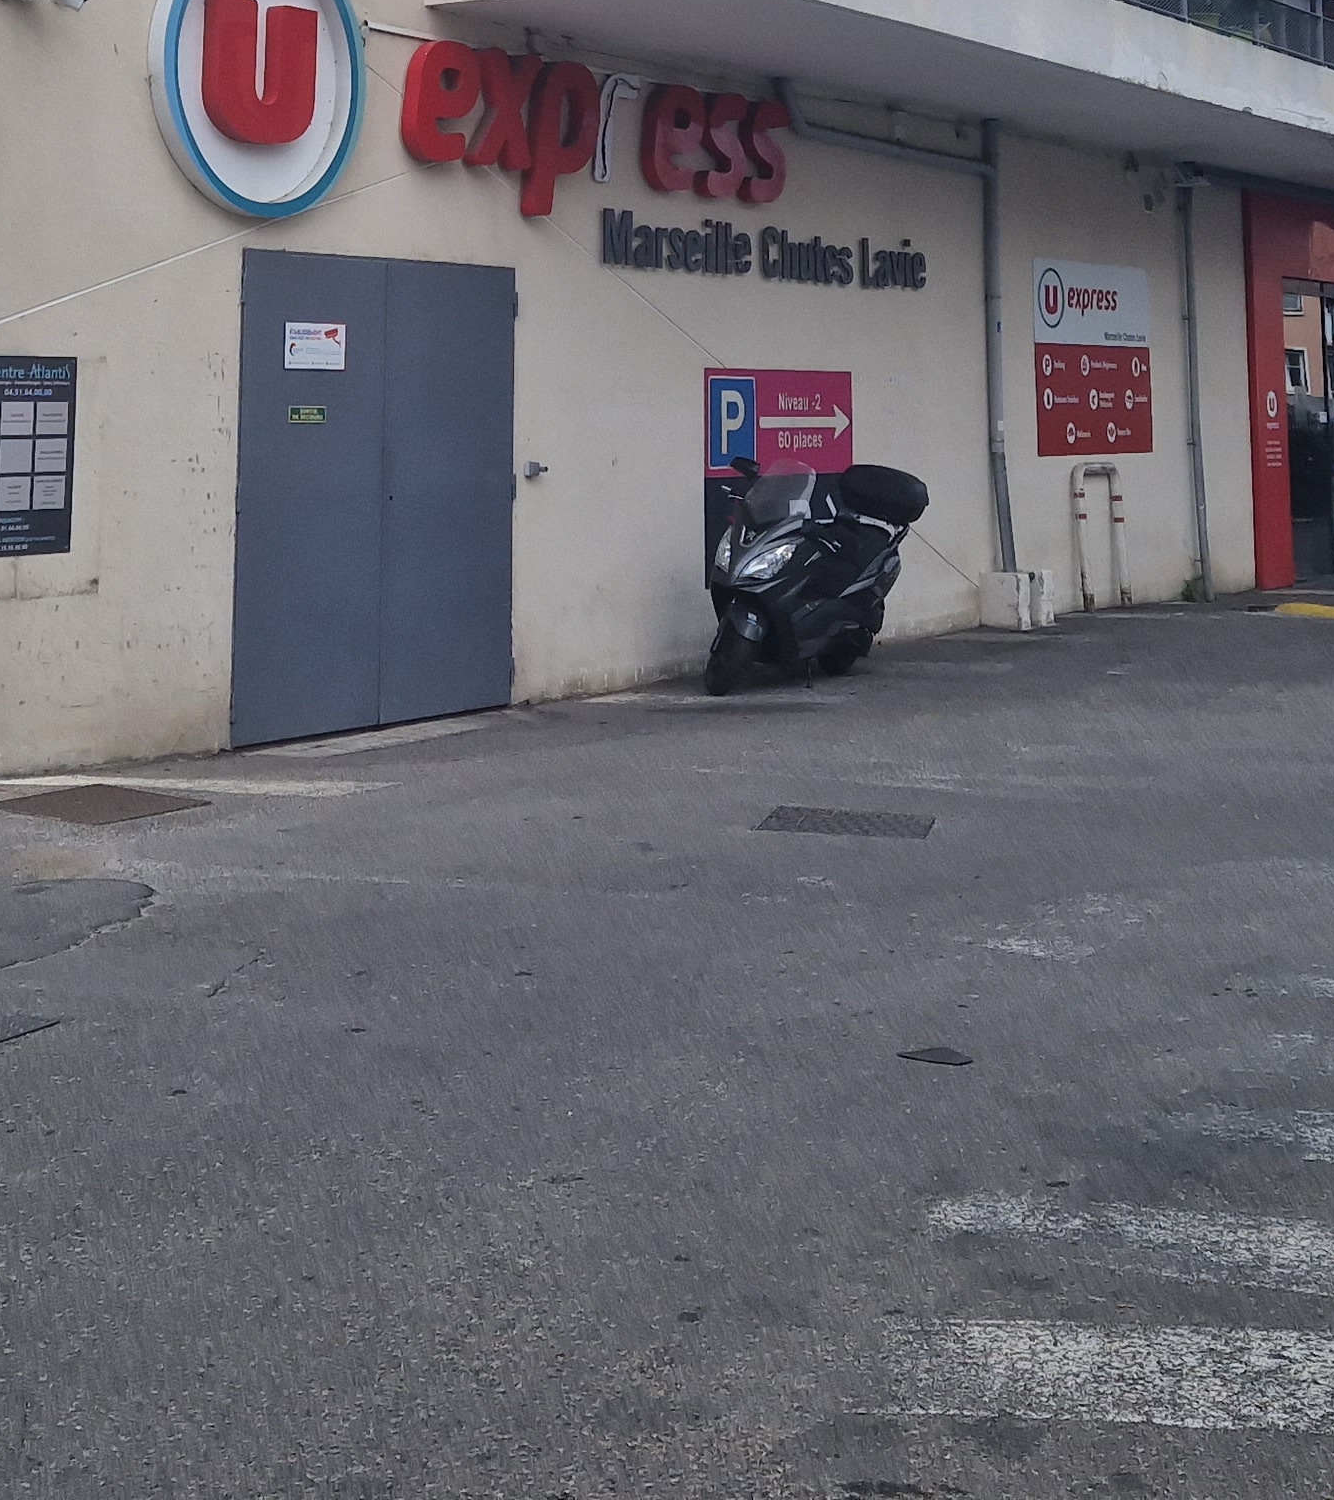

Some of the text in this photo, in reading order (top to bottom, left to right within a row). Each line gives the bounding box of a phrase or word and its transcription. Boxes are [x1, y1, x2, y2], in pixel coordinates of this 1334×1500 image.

[401, 39, 791, 217] express
[601, 207, 927, 289] Marseille Chutes Lavie
[1044, 284, 1118, 317] U express
[720, 389, 747, 455] P
[778, 392, 822, 411] Niveau -2
[778, 431, 823, 452] 60 places
